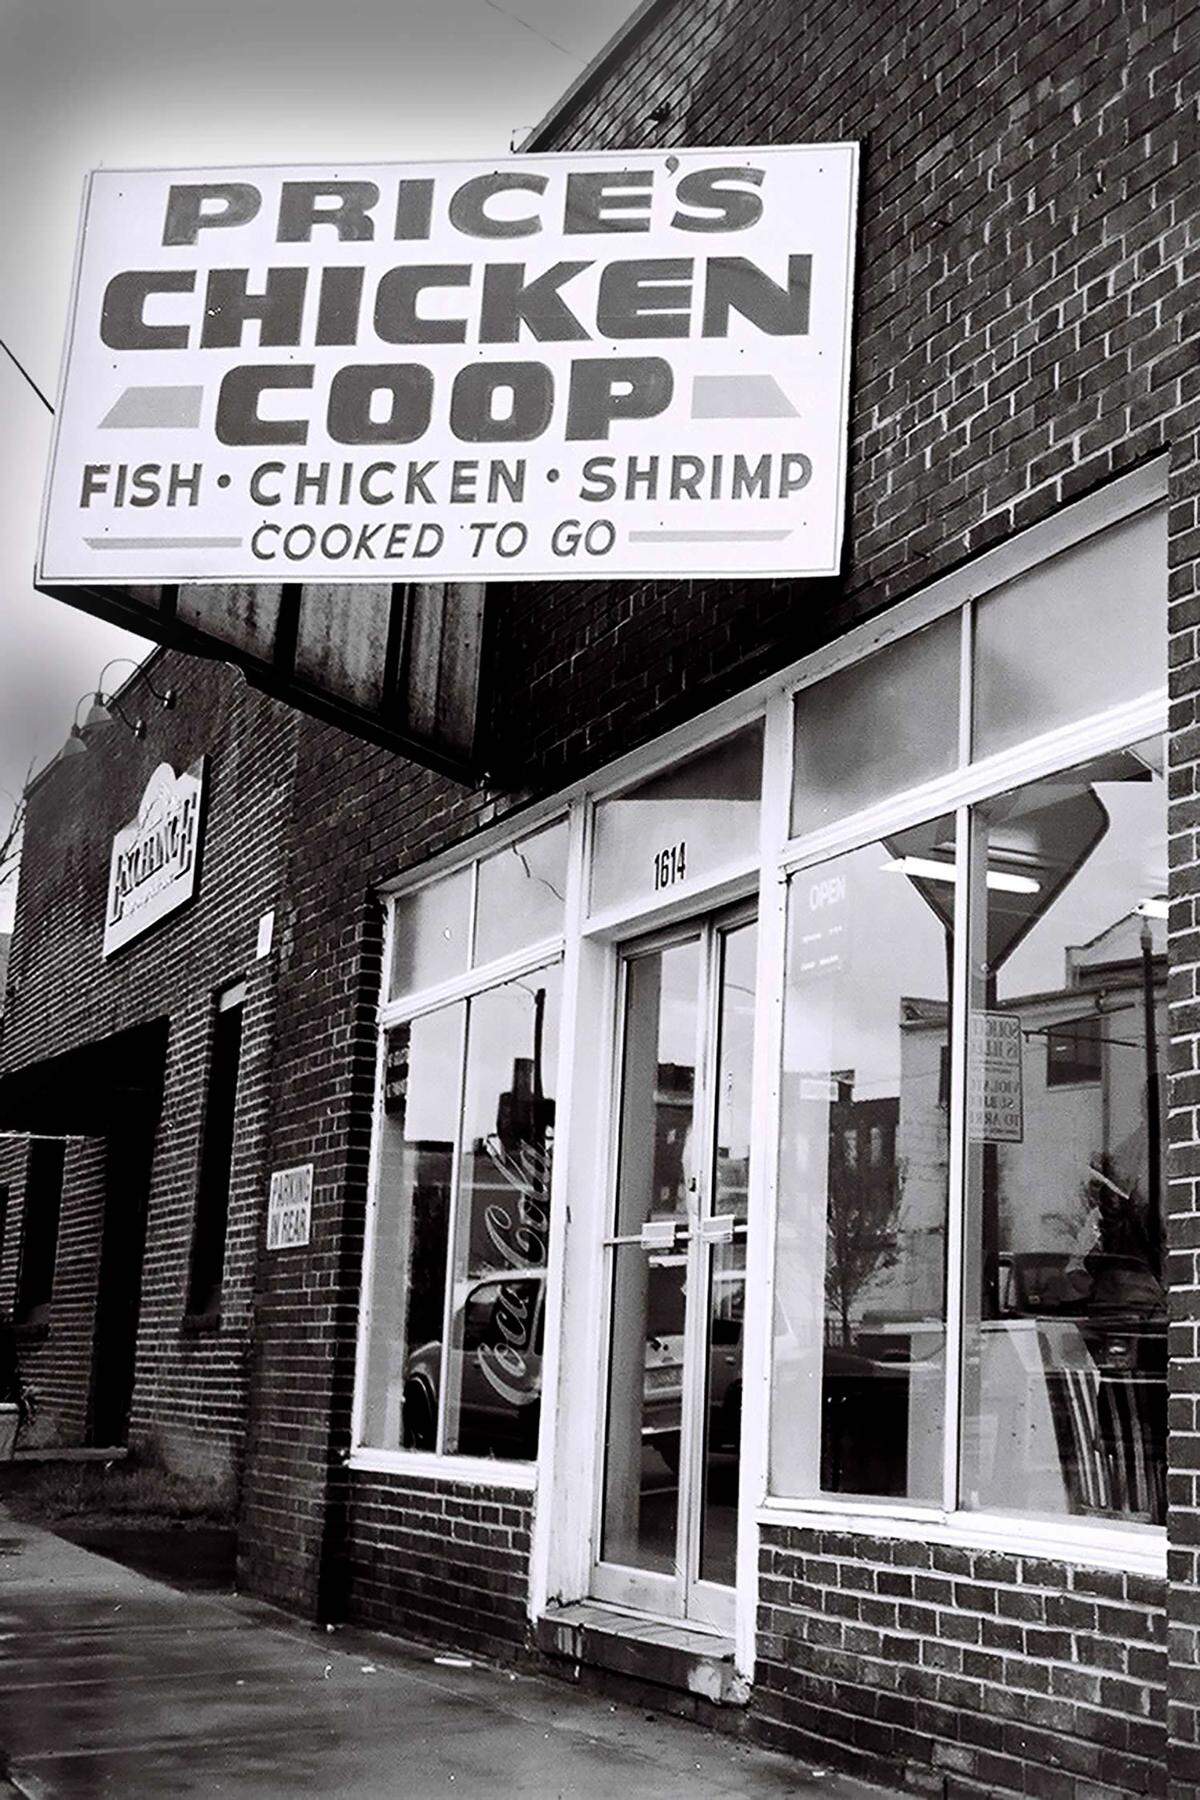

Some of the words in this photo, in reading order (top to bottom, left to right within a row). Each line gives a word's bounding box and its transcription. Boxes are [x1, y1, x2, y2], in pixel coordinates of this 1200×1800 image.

[161, 158, 765, 247] PRICE'S
[99, 253, 813, 351] CHICKEN
[214, 356, 674, 447] COOP
[79, 463, 203, 509] FISH
[249, 459, 526, 507] CHICKEN
[579, 453, 813, 502] SHRIMP
[251, 523, 444, 561] COOKED
[469, 521, 528, 558] TO
[551, 519, 616, 557] GO
[654, 841, 686, 891] 1614
[810, 876, 847, 911] OPEN
[272, 1167, 311, 1209] PARKING
[282, 1208, 308, 1244] REAR
